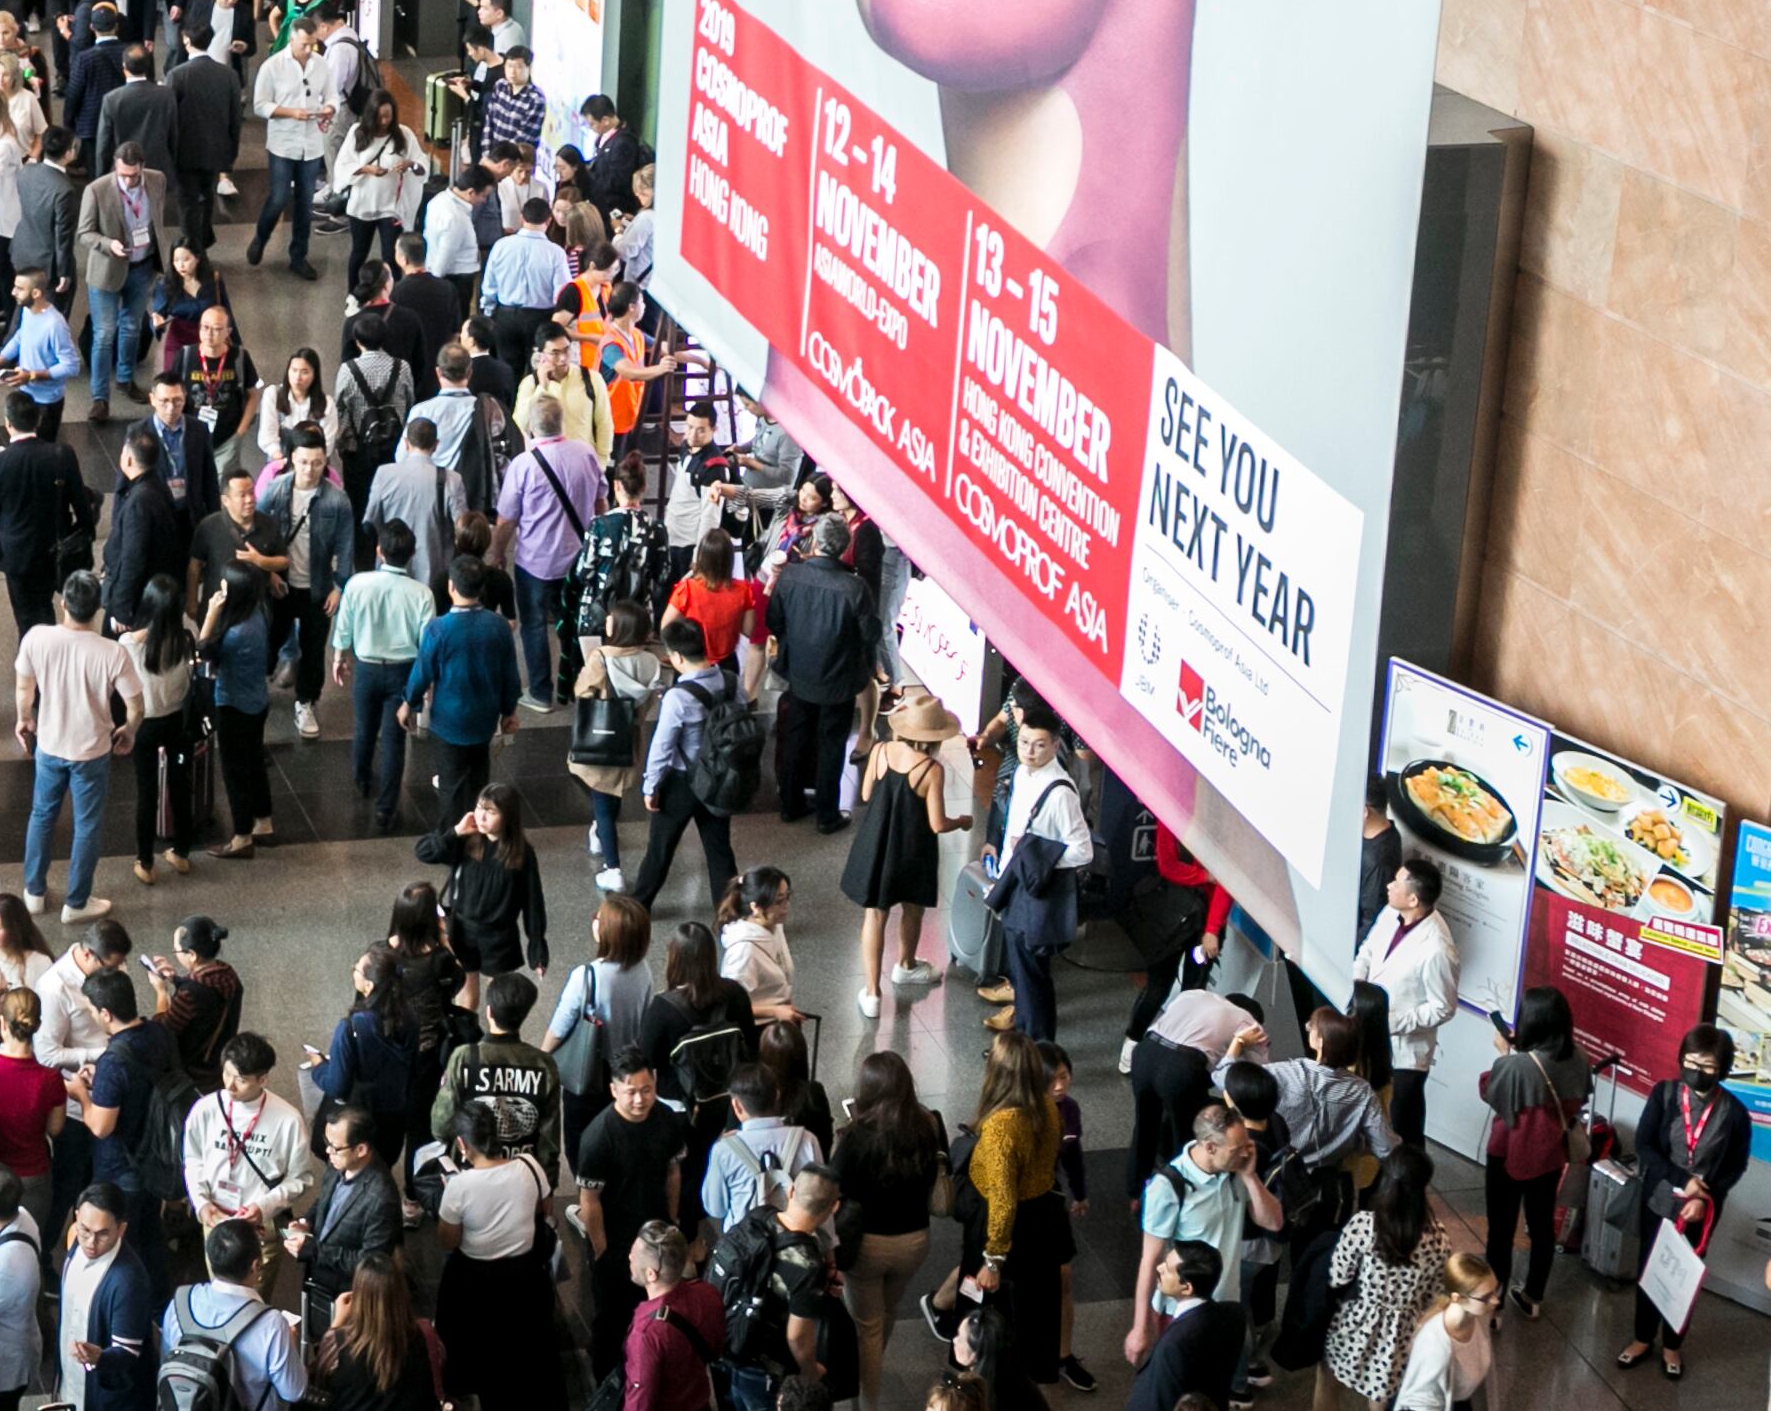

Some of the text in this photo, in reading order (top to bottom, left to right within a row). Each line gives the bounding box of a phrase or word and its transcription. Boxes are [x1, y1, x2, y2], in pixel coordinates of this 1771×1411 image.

[692, 106, 728, 168] ASIA
[696, 46, 789, 158] COSMOPROF
[824, 98, 897, 205] 12 14
[690, 158, 769, 262] HONG KONG
[816, 171, 941, 329] NOVEMBER
[814, 242, 908, 351] ASIAWORLD-EXPO
[975, 223, 1059, 346] 13 15
[808, 331, 936, 482] COSMOPACK ASIA
[968, 301, 1111, 484] NOVEMBER
[958, 419, 1090, 571] & EXHIBITION CENTRE
[963, 376, 1121, 547] HONG KONG CONVENTION
[1160, 376, 1280, 534] SEE YOU
[955, 472, 1109, 655] COSMOPROF ASIA
[1149, 462, 1315, 668] NEXT YEAR
[1203, 715, 1238, 768] Fiere
[1206, 685, 1271, 770] Bologna
[492, 1068, 542, 1095] ARMY
